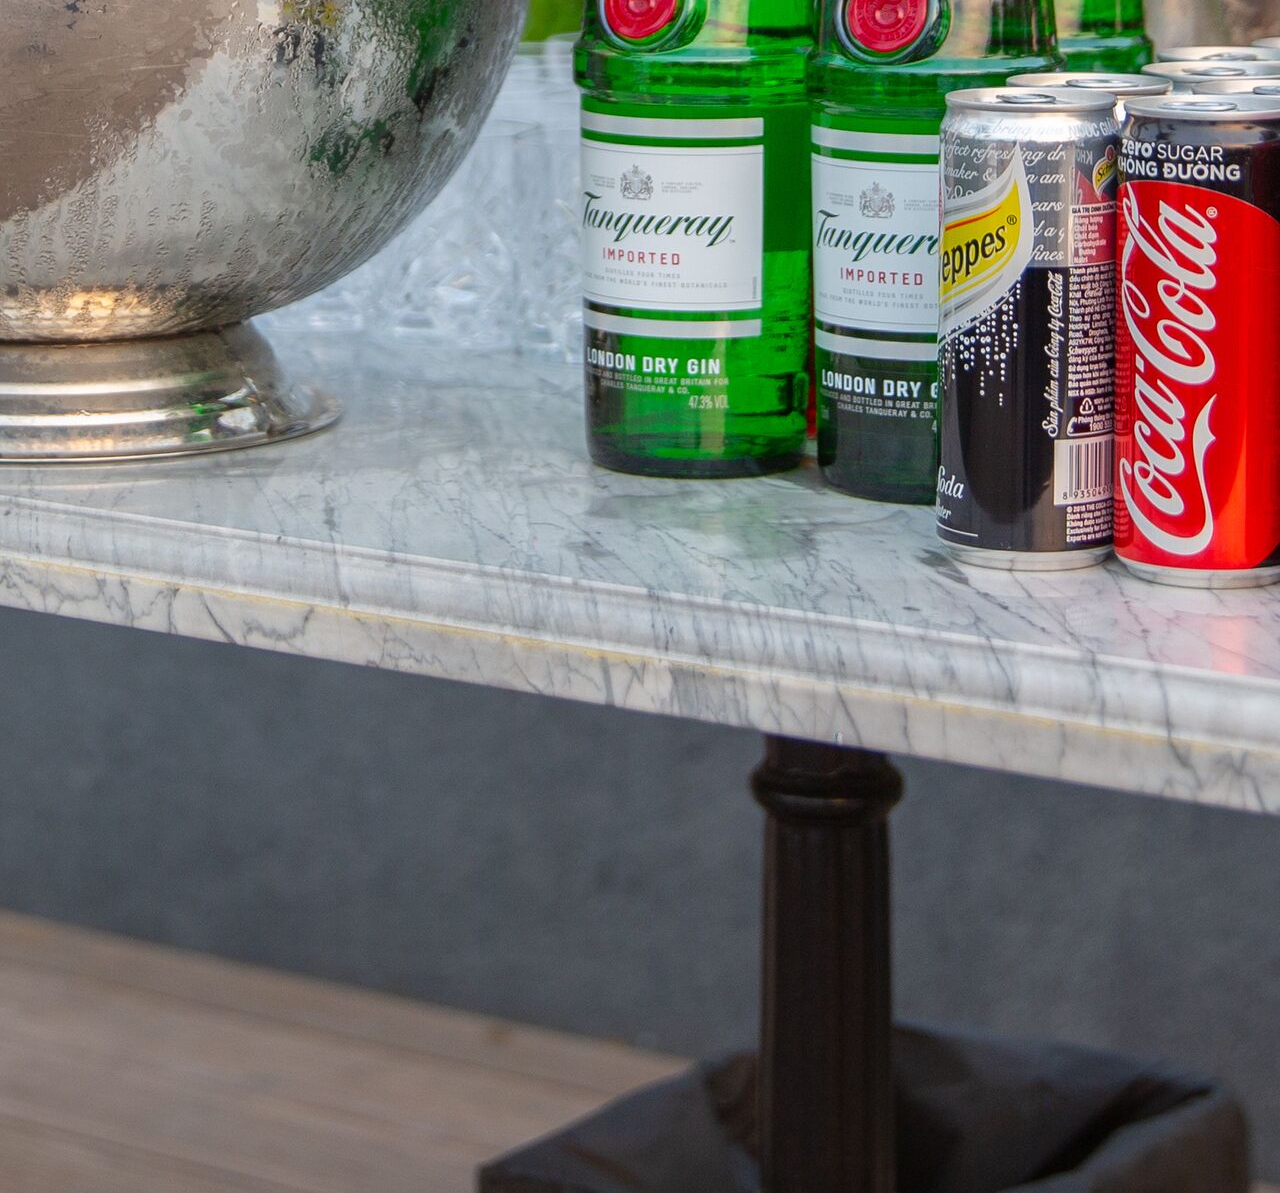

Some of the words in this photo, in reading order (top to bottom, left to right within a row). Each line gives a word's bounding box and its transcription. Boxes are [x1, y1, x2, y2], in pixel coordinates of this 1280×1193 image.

[1121, 139, 1153, 158] zero
[1157, 143, 1224, 162] SUGAR
[1162, 161, 1241, 182] ĐƯỜNG
[582, 191, 735, 247] Tanqueray
[602, 247, 681, 266] IMPORTED
[840, 267, 923, 286] IMPORTED
[586, 346, 636, 371] LONDON
[642, 356, 679, 375] DRY
[687, 358, 721, 375] GIN
[821, 369, 876, 395] LONDON
[882, 380, 922, 398] DRY
[865, 406, 908, 419] TANQUERAY
[895, 400, 922, 410] GREAT
